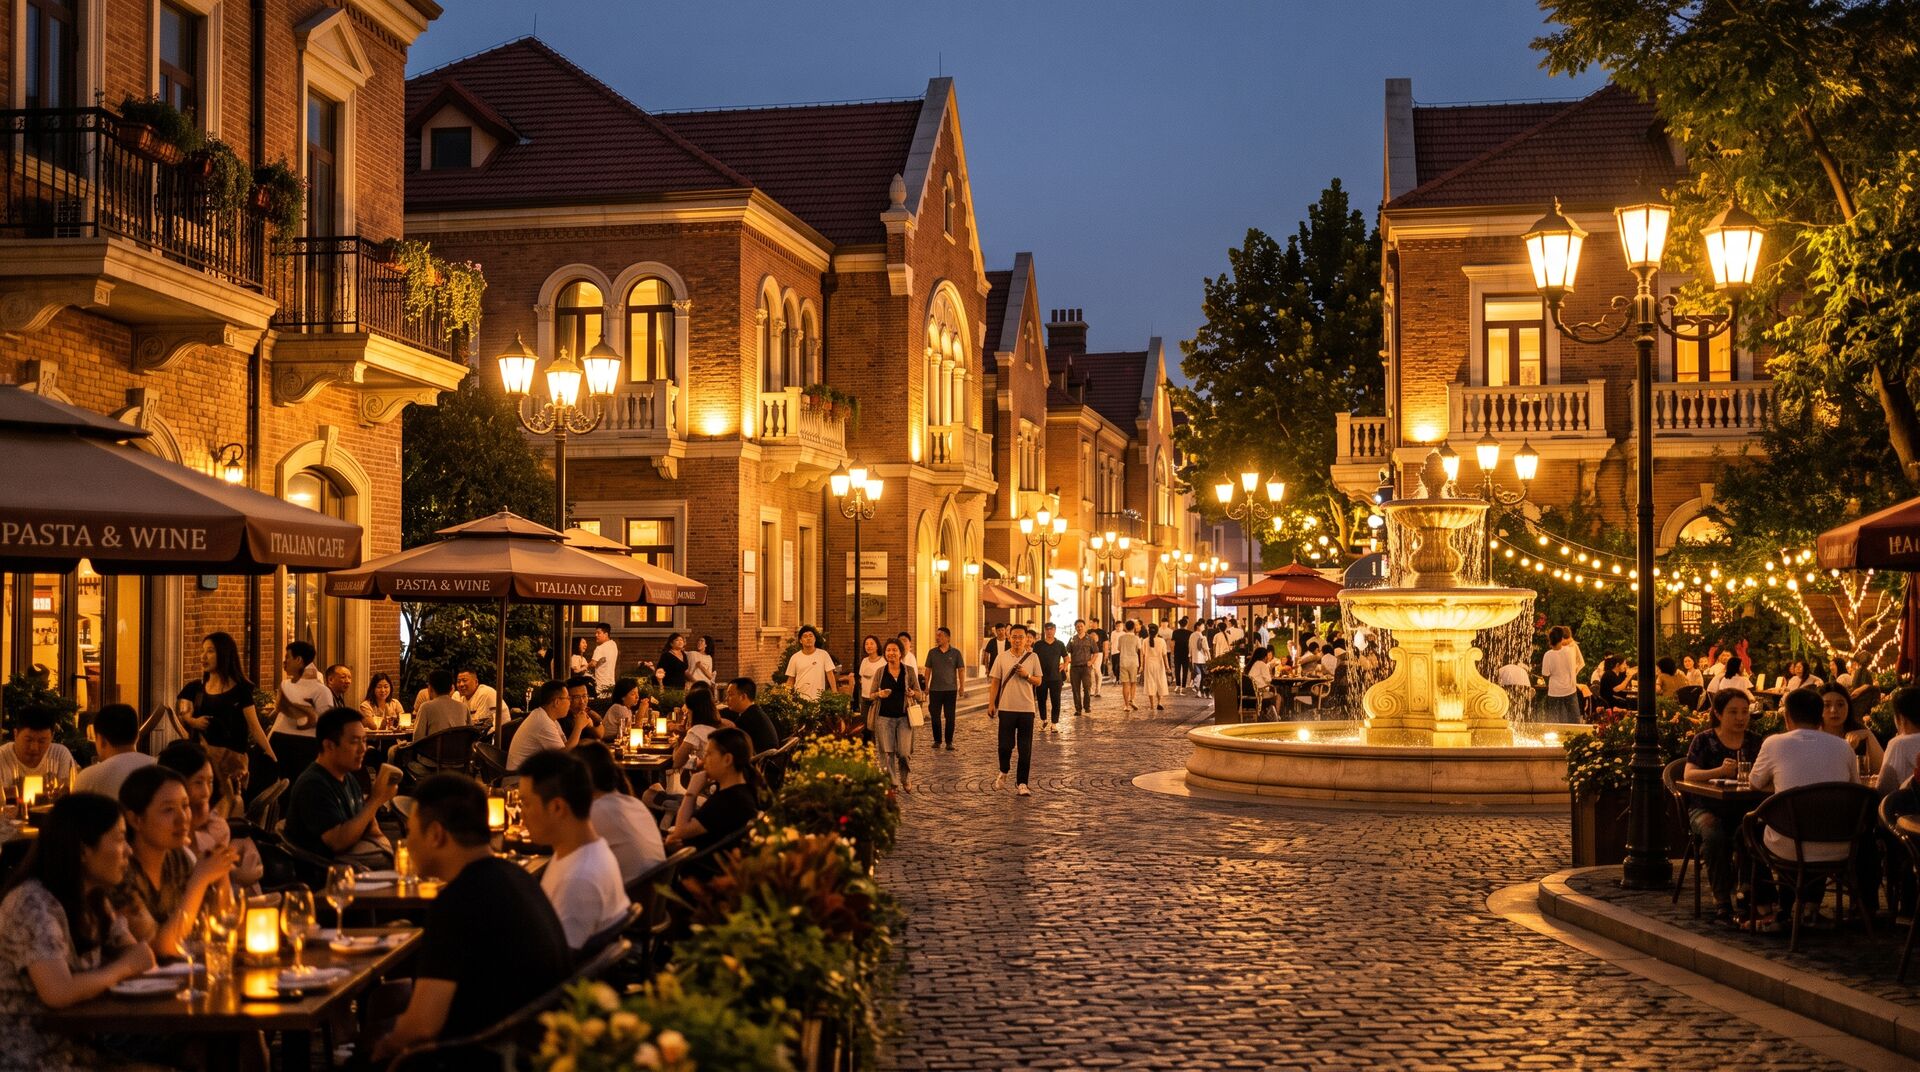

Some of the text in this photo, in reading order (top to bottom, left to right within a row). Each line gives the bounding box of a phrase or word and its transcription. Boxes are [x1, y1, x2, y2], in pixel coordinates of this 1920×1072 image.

[1, 522, 207, 550] PASTA & WINE
[270, 532, 345, 558] ITALIAN CAFE
[395, 579, 490, 592] PASTA & WINE
[535, 581, 623, 597] ITALIAN CAFE
